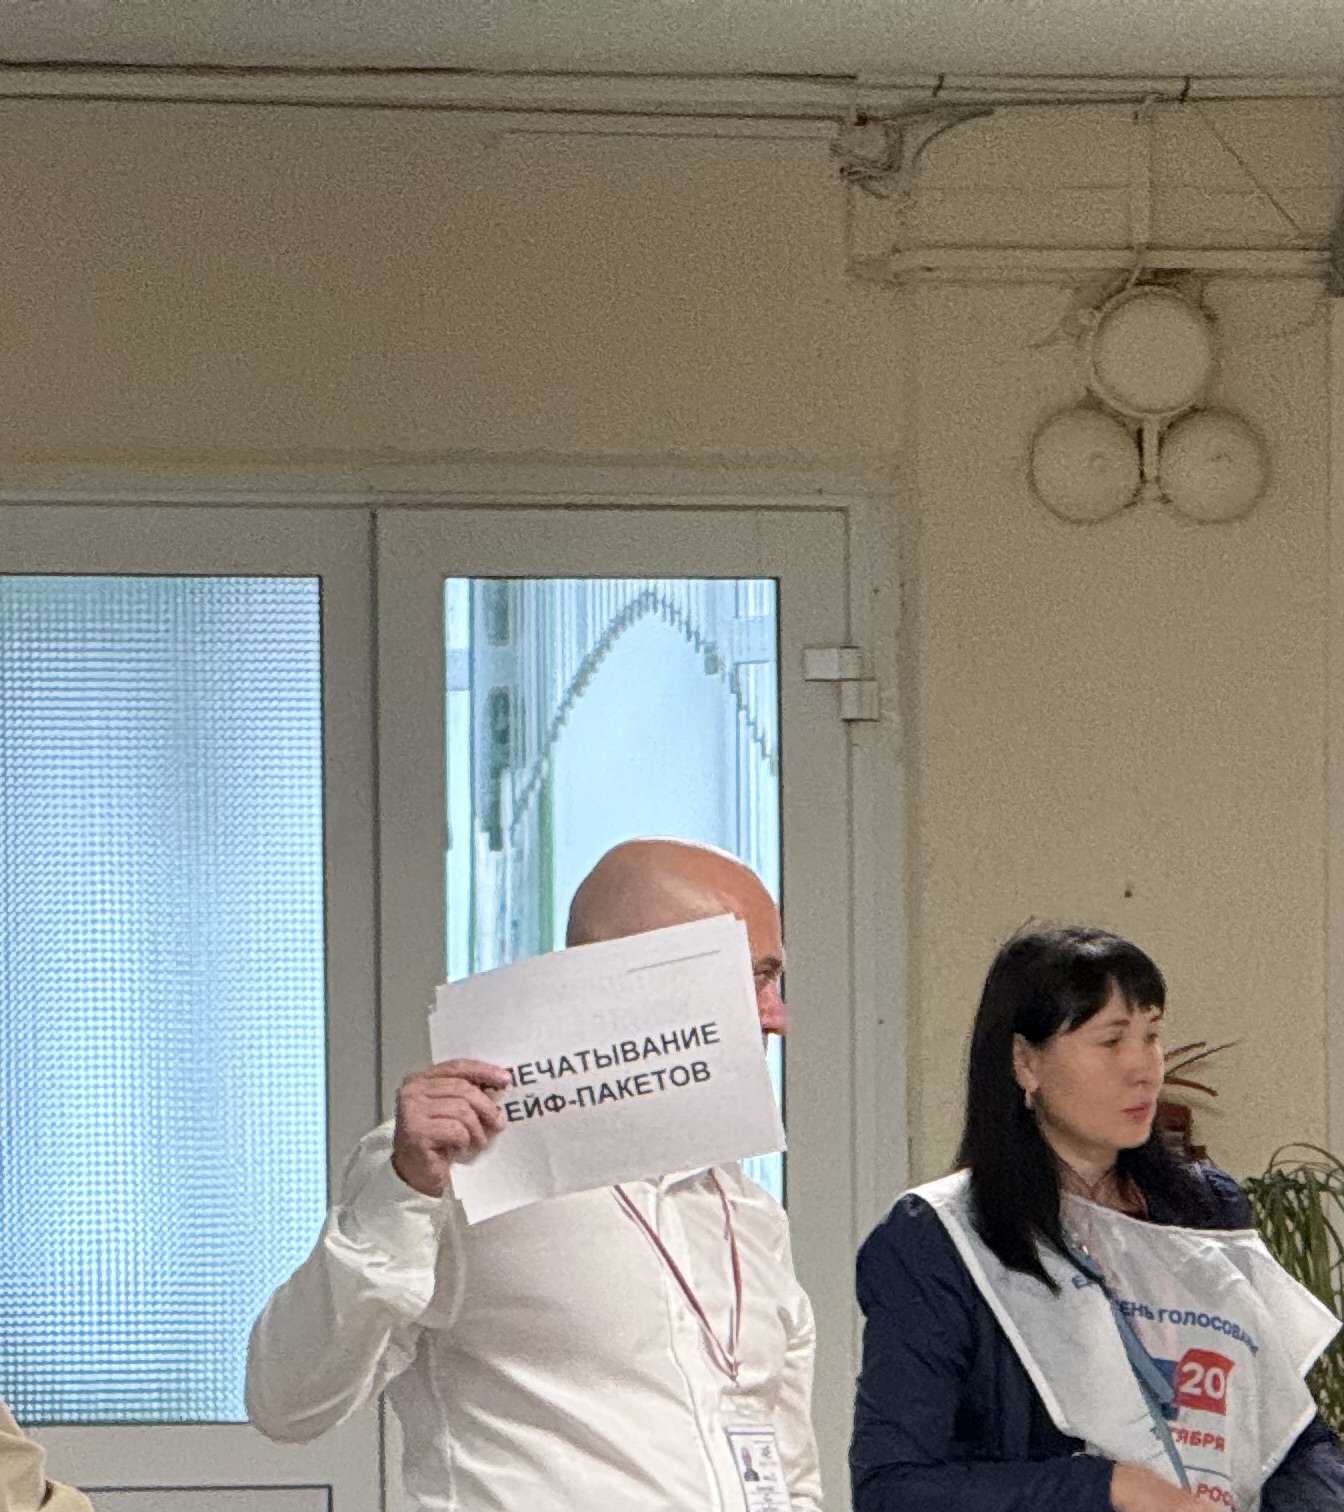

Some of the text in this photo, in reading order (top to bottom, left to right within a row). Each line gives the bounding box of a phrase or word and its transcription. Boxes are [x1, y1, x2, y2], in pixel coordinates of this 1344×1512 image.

[497, 1061, 711, 1123] ЕЙФ-ПАКЕТОВ
[1119, 1300, 1155, 1320] ЕНЬ
[1181, 1361, 1226, 1400] 20
